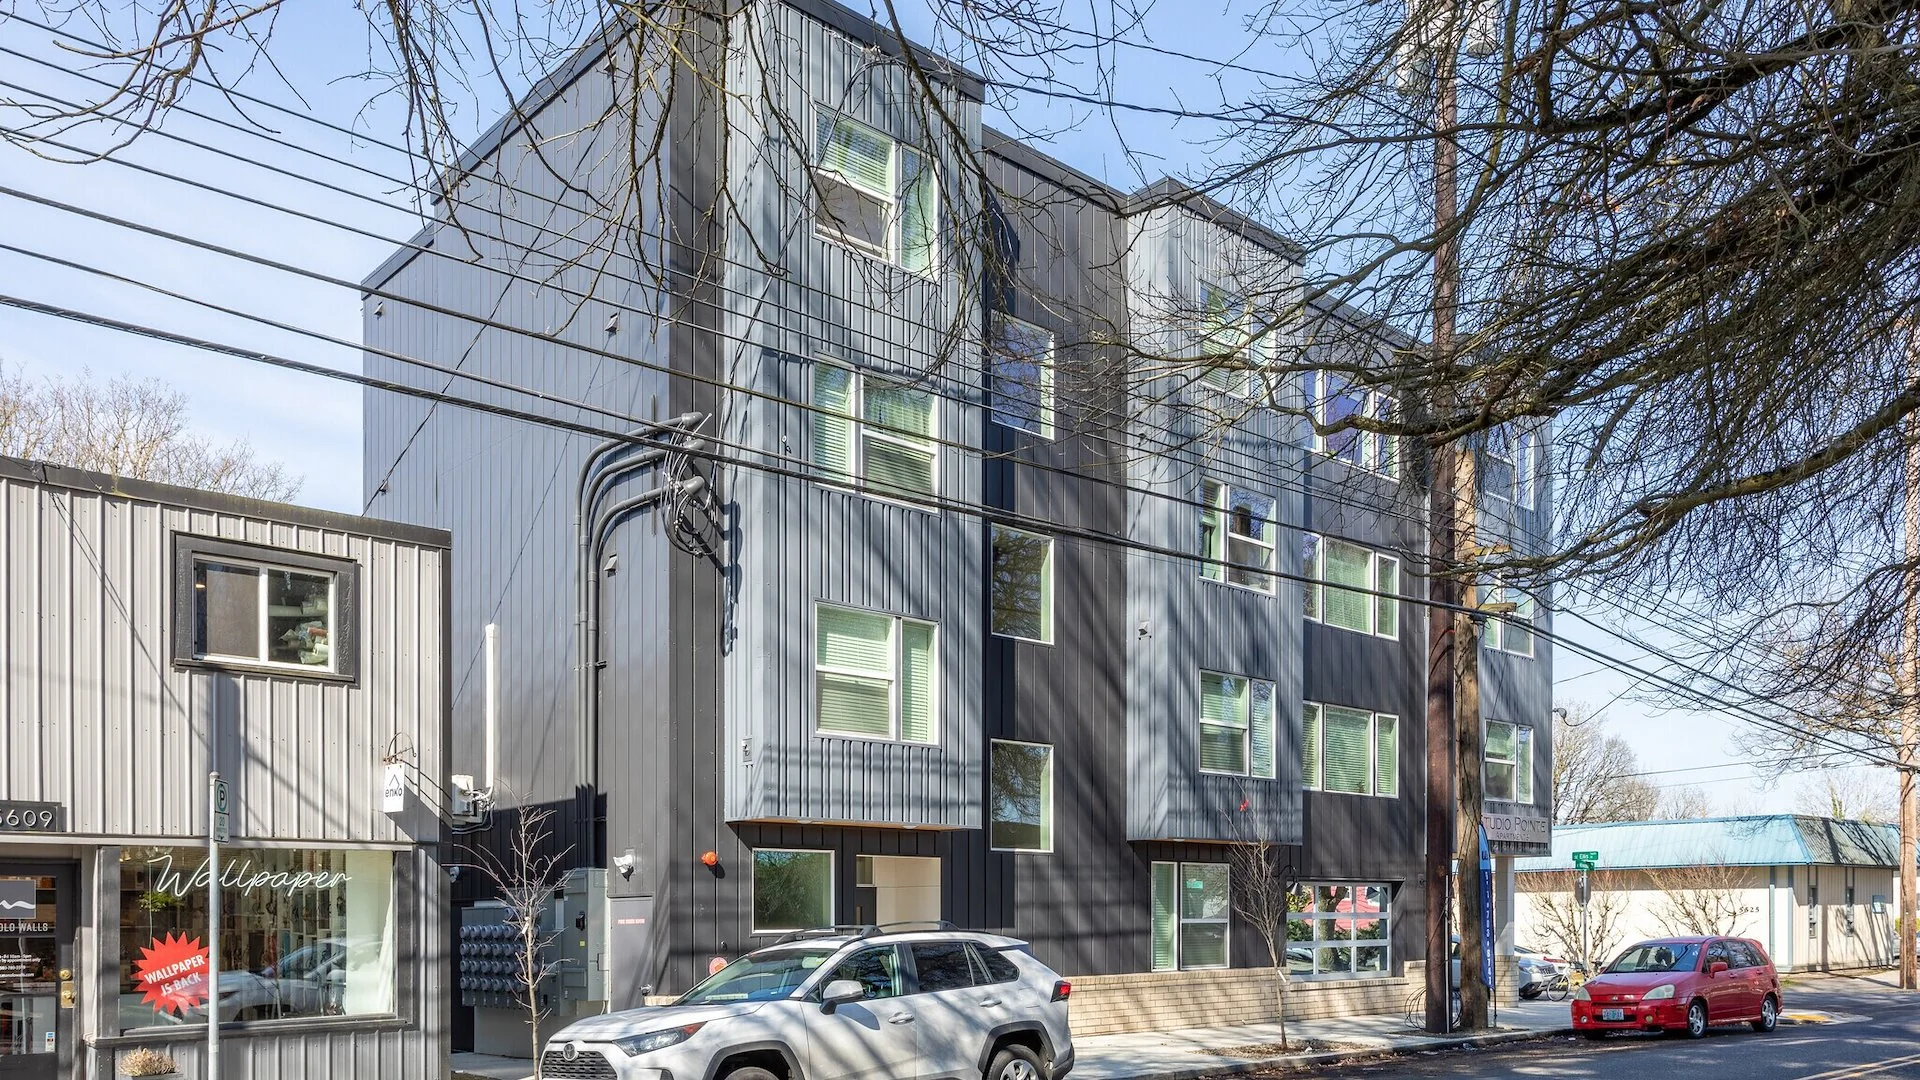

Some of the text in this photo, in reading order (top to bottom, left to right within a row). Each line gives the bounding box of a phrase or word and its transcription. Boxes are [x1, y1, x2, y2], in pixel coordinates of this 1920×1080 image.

[385, 788, 402, 797] enko
[0, 809, 53, 827] 609
[1514, 817, 1546, 832] POINTE
[147, 855, 352, 897] Wallpaper
[20, 922, 49, 932] WALLS
[144, 955, 206, 985] WALLPAPER
[161, 971, 202, 995] IS BACK
